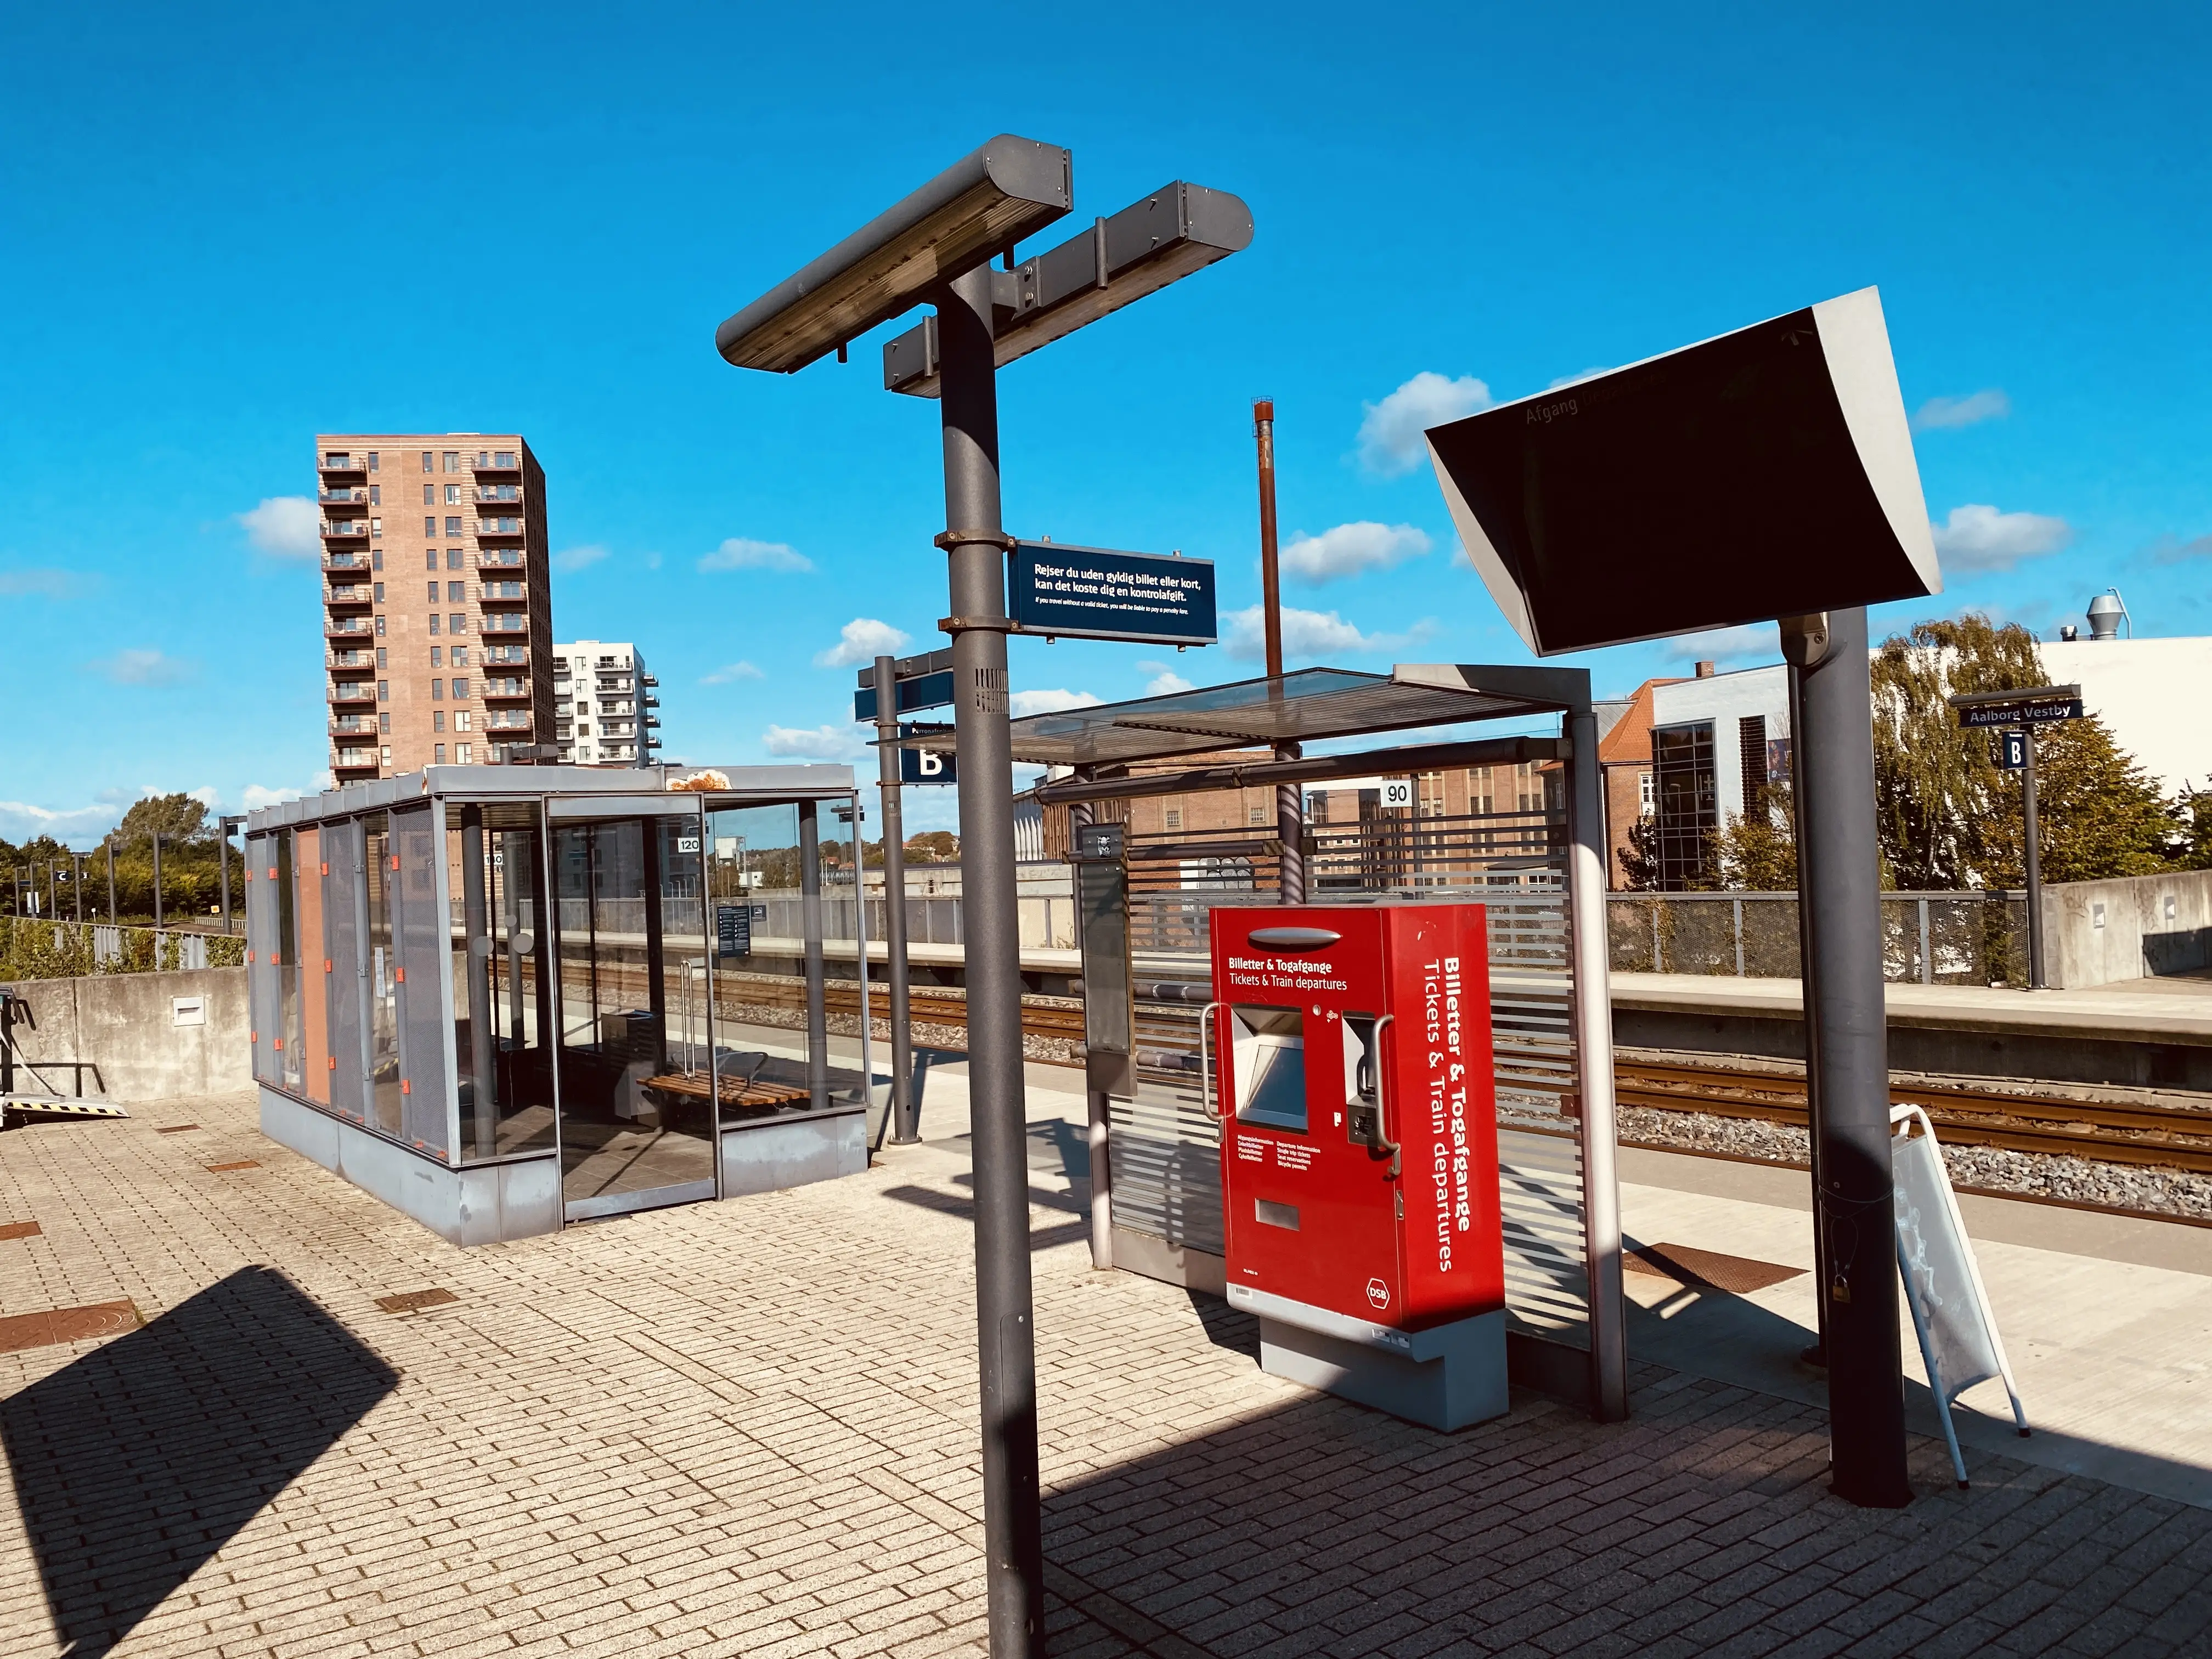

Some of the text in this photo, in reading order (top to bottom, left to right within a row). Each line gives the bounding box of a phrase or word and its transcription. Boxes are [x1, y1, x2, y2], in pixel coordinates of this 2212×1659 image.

[1526, 398, 1578, 425] Afgang
[1035, 564, 1201, 591] Rejser du uden gyldig billet eller kort,
[1035, 578, 1187, 602] kan det koste dig en kontrolafgift.
[1971, 705, 2070, 722] Aalborg Vestby
[919, 746, 943, 775] B
[2011, 741, 2021, 764] B
[1388, 785, 1407, 802] 90
[681, 840, 698, 849] 120
[1229, 957, 1332, 975] Billetter & Togafgange
[1229, 973, 1347, 991] Tickets & Train departures
[1444, 957, 1471, 1232] Billetter & Togafgange
[1425, 958, 1452, 1273] Tickets & Train departures
[1276, 1141, 1296, 1149] Departure
[1370, 1287, 1386, 1300] DSB
